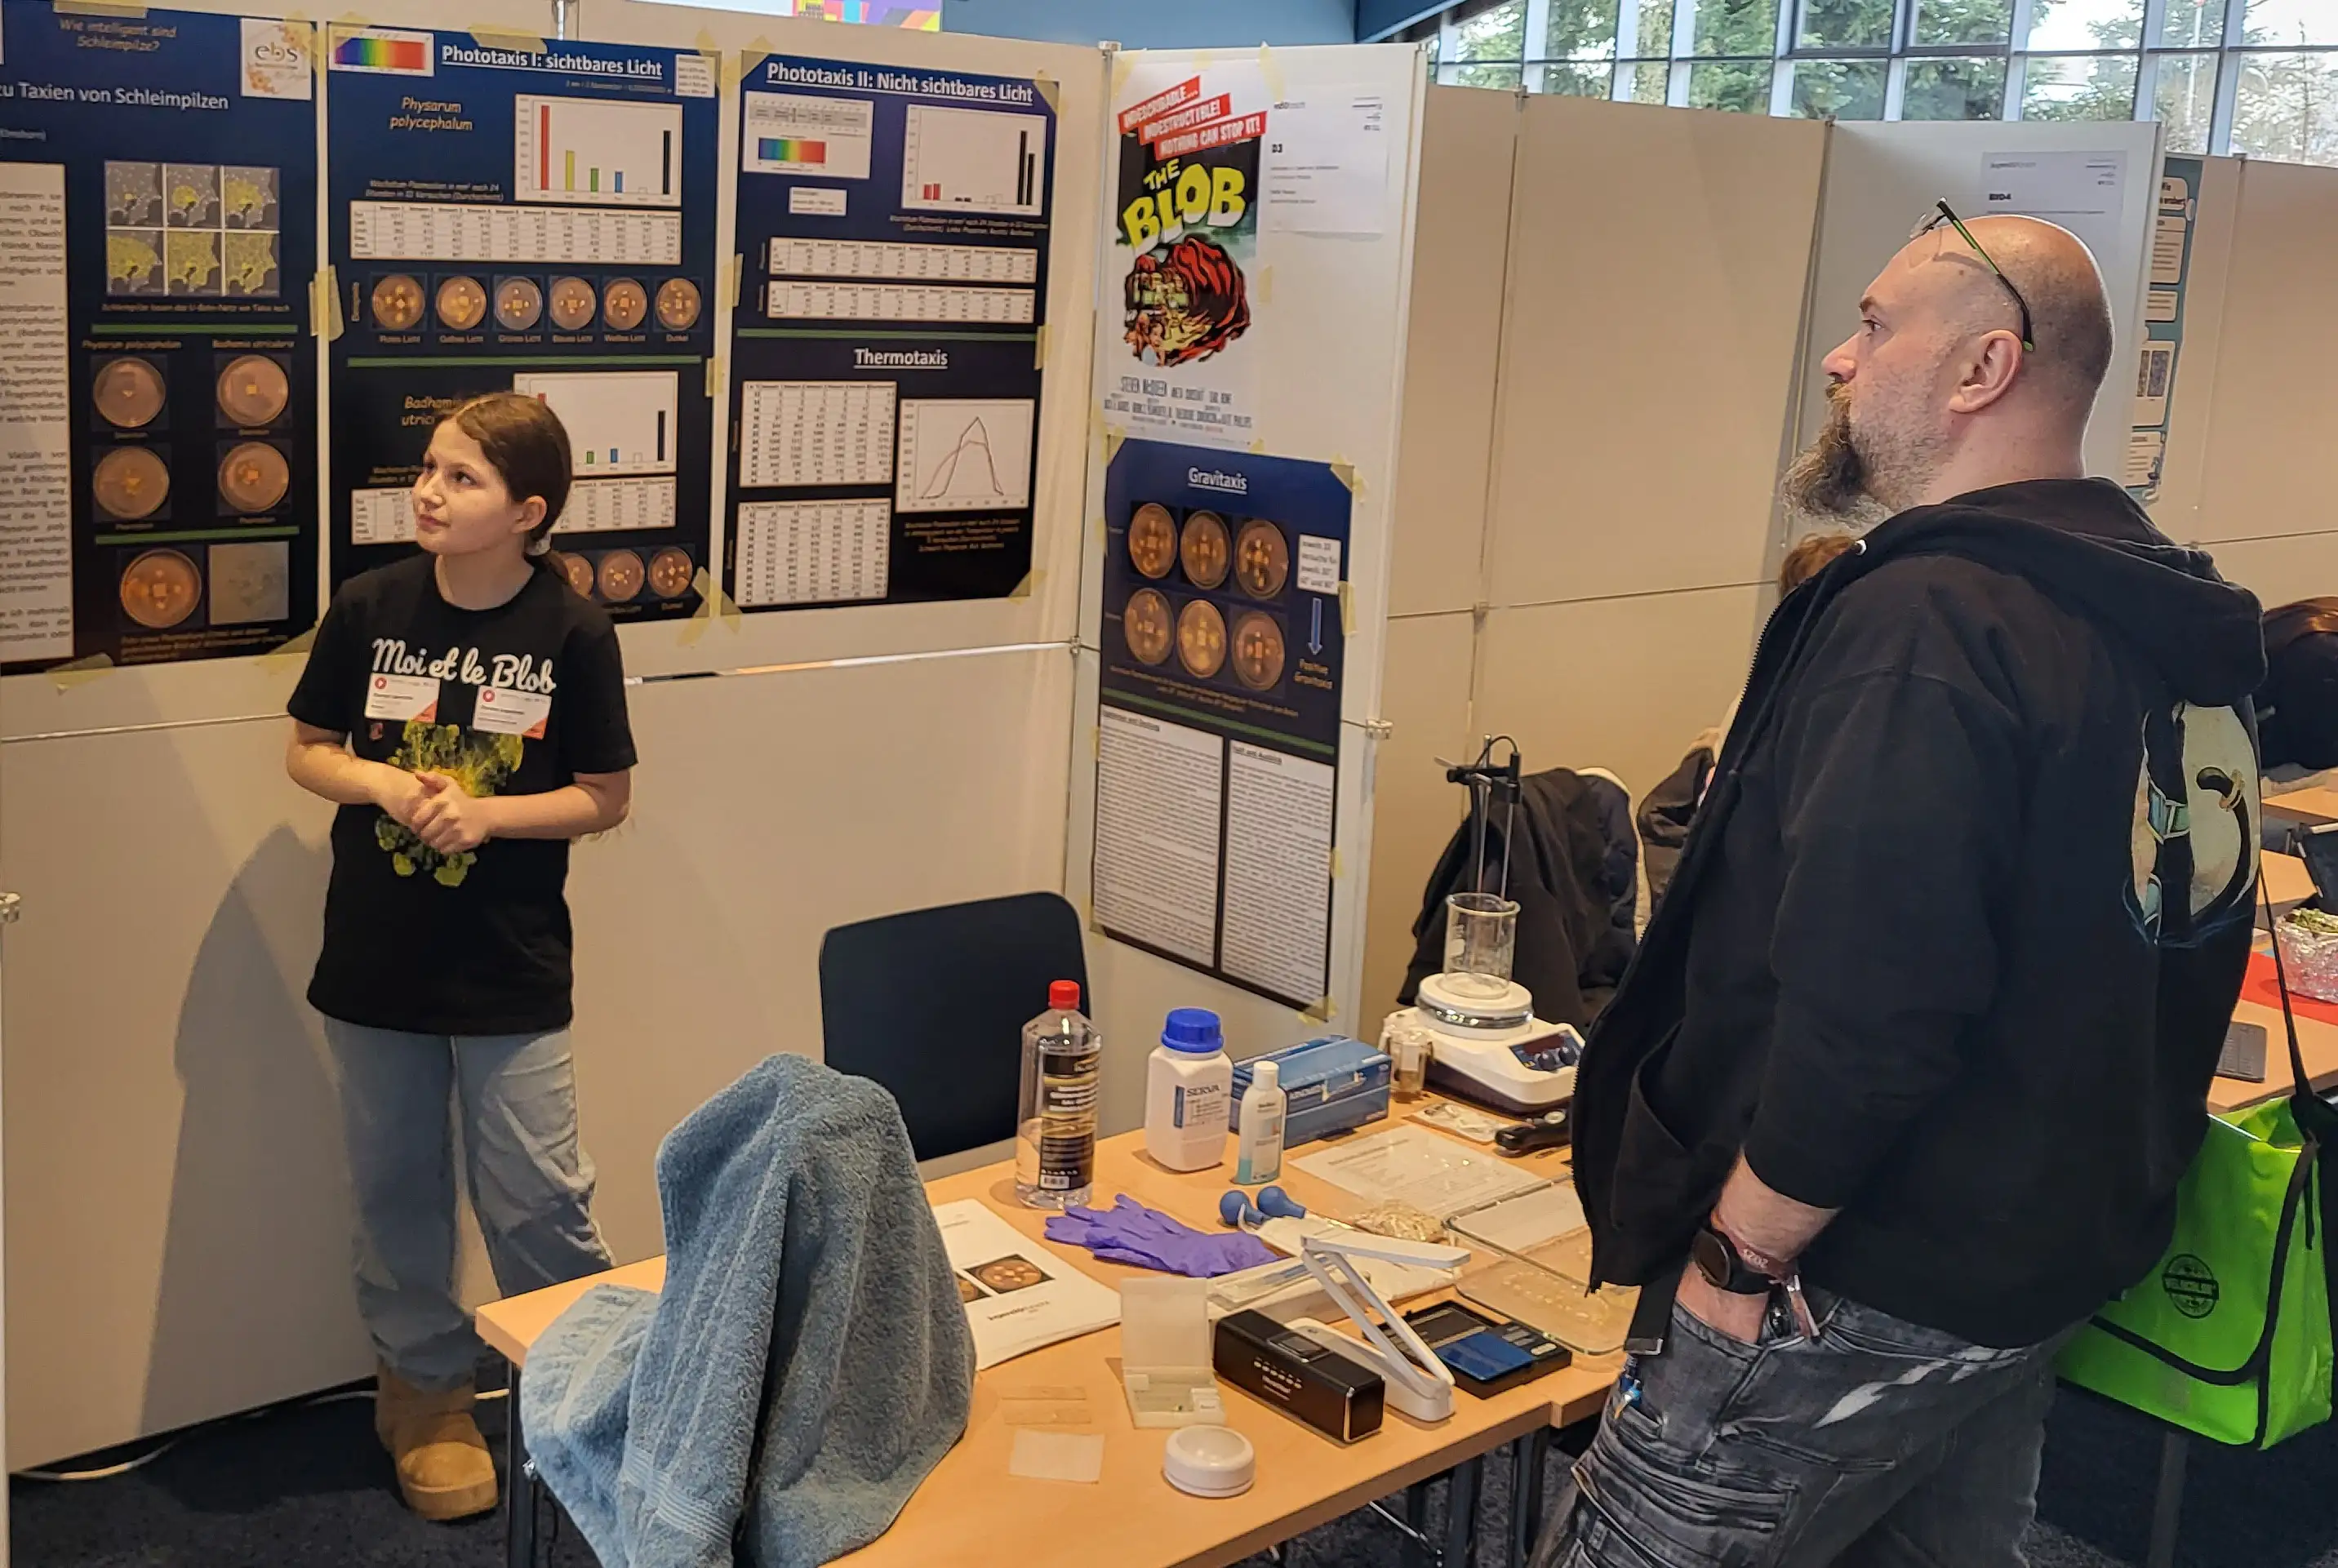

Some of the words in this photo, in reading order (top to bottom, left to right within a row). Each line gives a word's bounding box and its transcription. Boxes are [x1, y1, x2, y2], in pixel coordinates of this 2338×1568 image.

[255, 42, 298, 63] ebs
[442, 45, 527, 66] Phototaxis
[531, 52, 541, 67] I:
[546, 54, 624, 73] sichtbares
[627, 59, 662, 76] Licht
[18, 81, 74, 100] Taxien
[78, 87, 111, 103] von
[113, 87, 229, 110] Schleimpilzen
[767, 62, 854, 87] Phototaxis
[858, 71, 873, 87] II:
[877, 73, 918, 91] Nicht
[921, 77, 996, 99] sichtbares
[998, 83, 1033, 103] Licht
[402, 96, 461, 113] Physarum
[389, 114, 473, 131] polycephalum
[1200, 127, 1219, 145] CAN
[1220, 121, 1244, 140] STOP
[1245, 116, 1260, 135] IT!
[1143, 158, 1180, 190] THE
[1122, 162, 1247, 256] BLOB
[854, 348, 948, 366] Thermotaxis
[1189, 467, 1247, 491] Gravitaxis
[372, 637, 428, 675] Moi
[429, 646, 460, 682] et
[460, 647, 487, 686] le
[491, 654, 557, 693] Blob
[1186, 1084, 1220, 1097] SERVA
